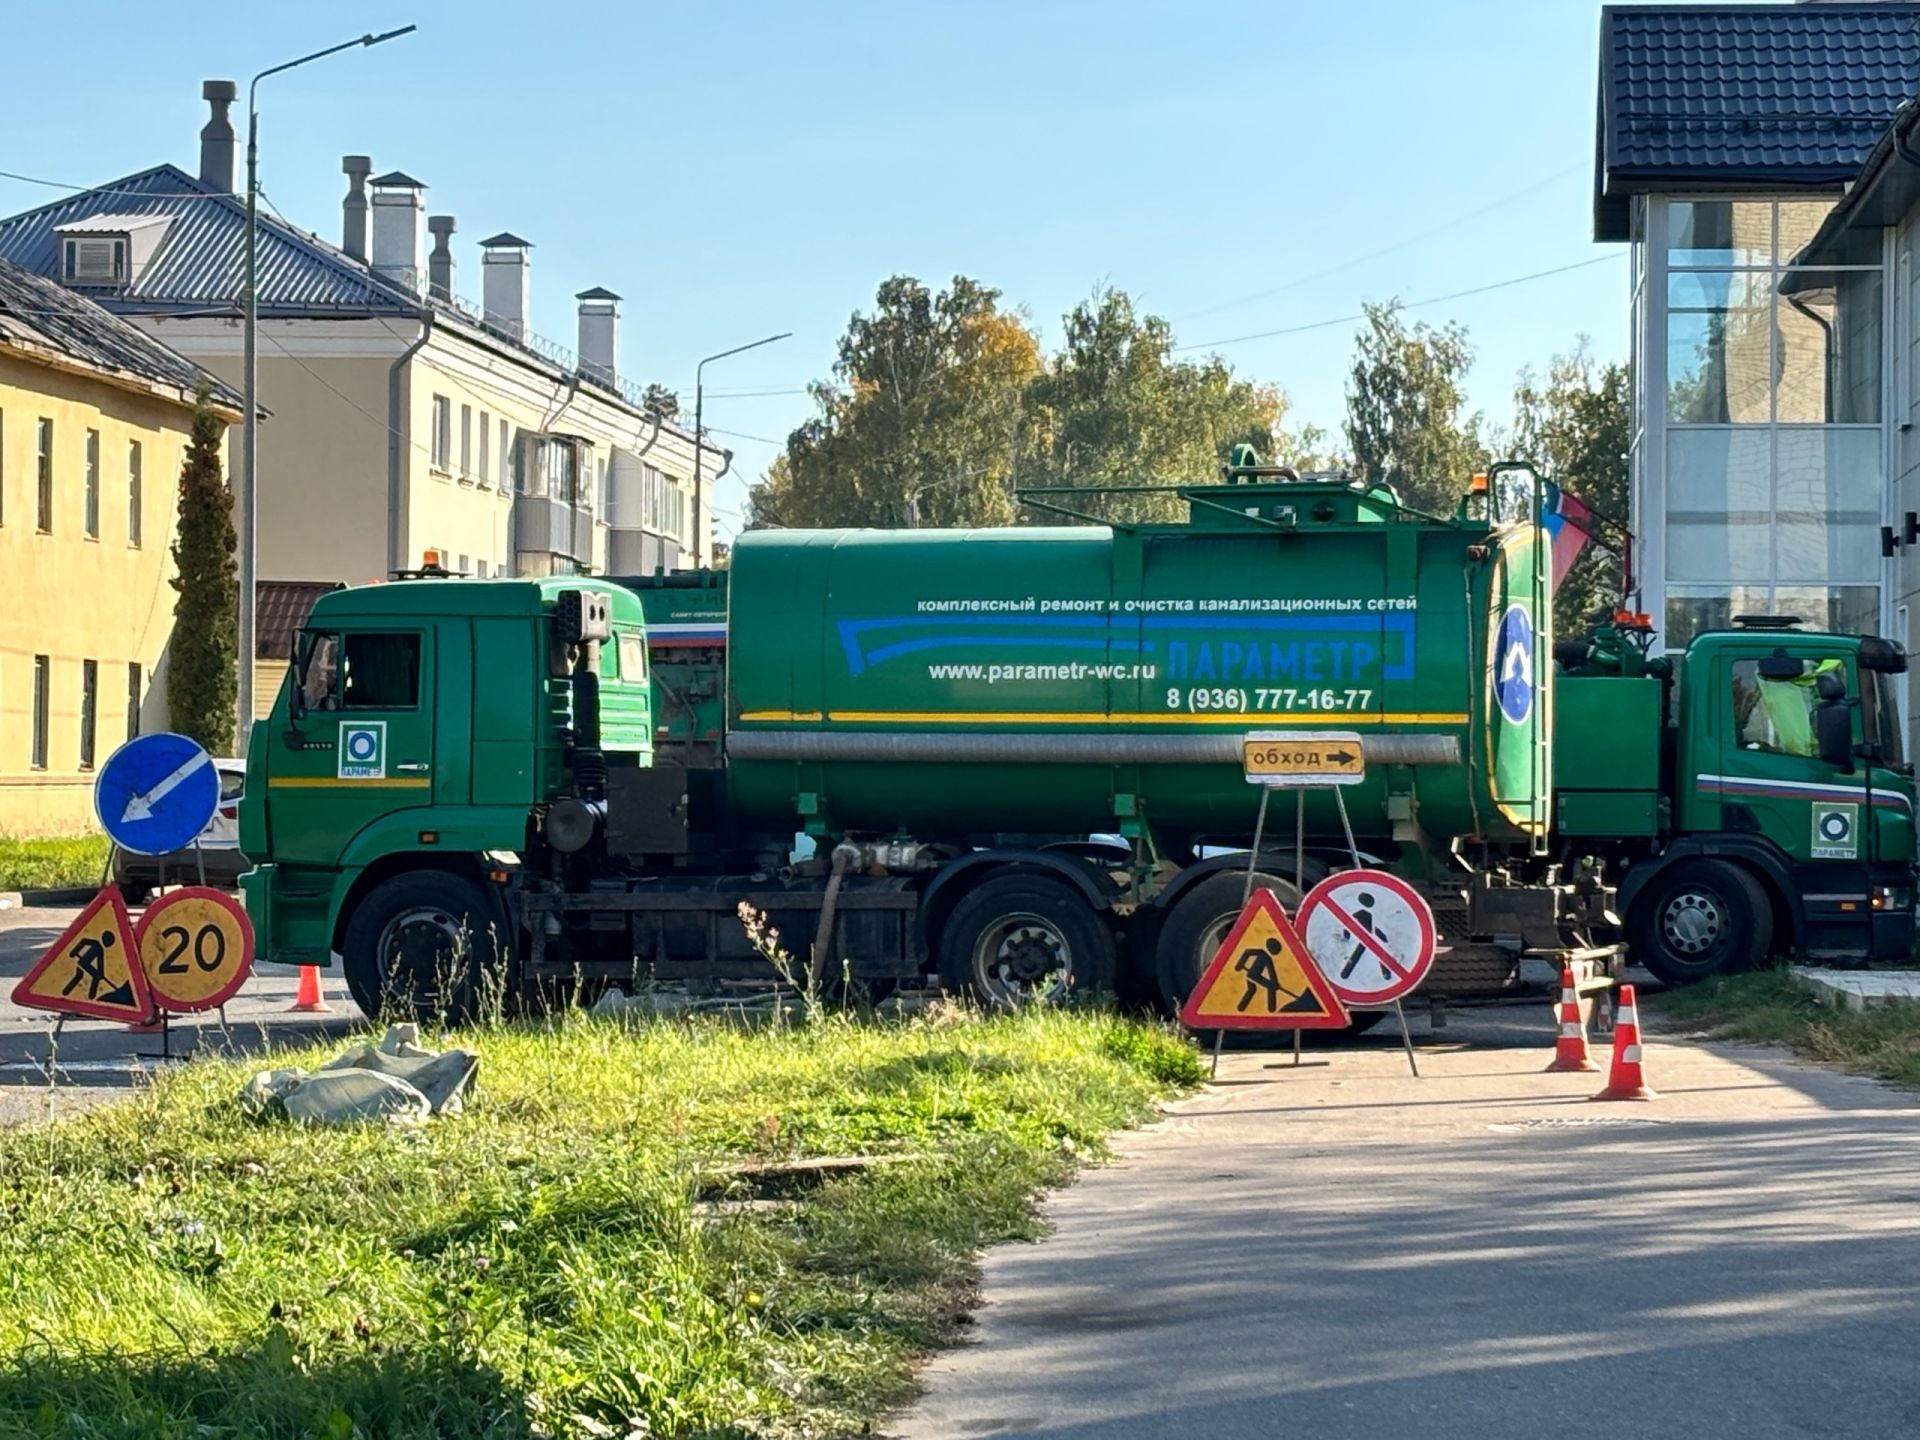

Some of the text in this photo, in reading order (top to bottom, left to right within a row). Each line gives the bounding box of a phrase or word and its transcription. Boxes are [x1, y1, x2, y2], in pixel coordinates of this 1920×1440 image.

[917, 595, 1417, 613] комплексный ремонт и очистка канализационных сетей
[1167, 640, 1374, 680] ПАРАМЕТР
[928, 662, 1156, 683] www.parametr-wc.ru
[1167, 688, 1372, 713] 8 (936) 777-16-77
[1253, 748, 1321, 766] обход
[158, 924, 225, 974] 20
